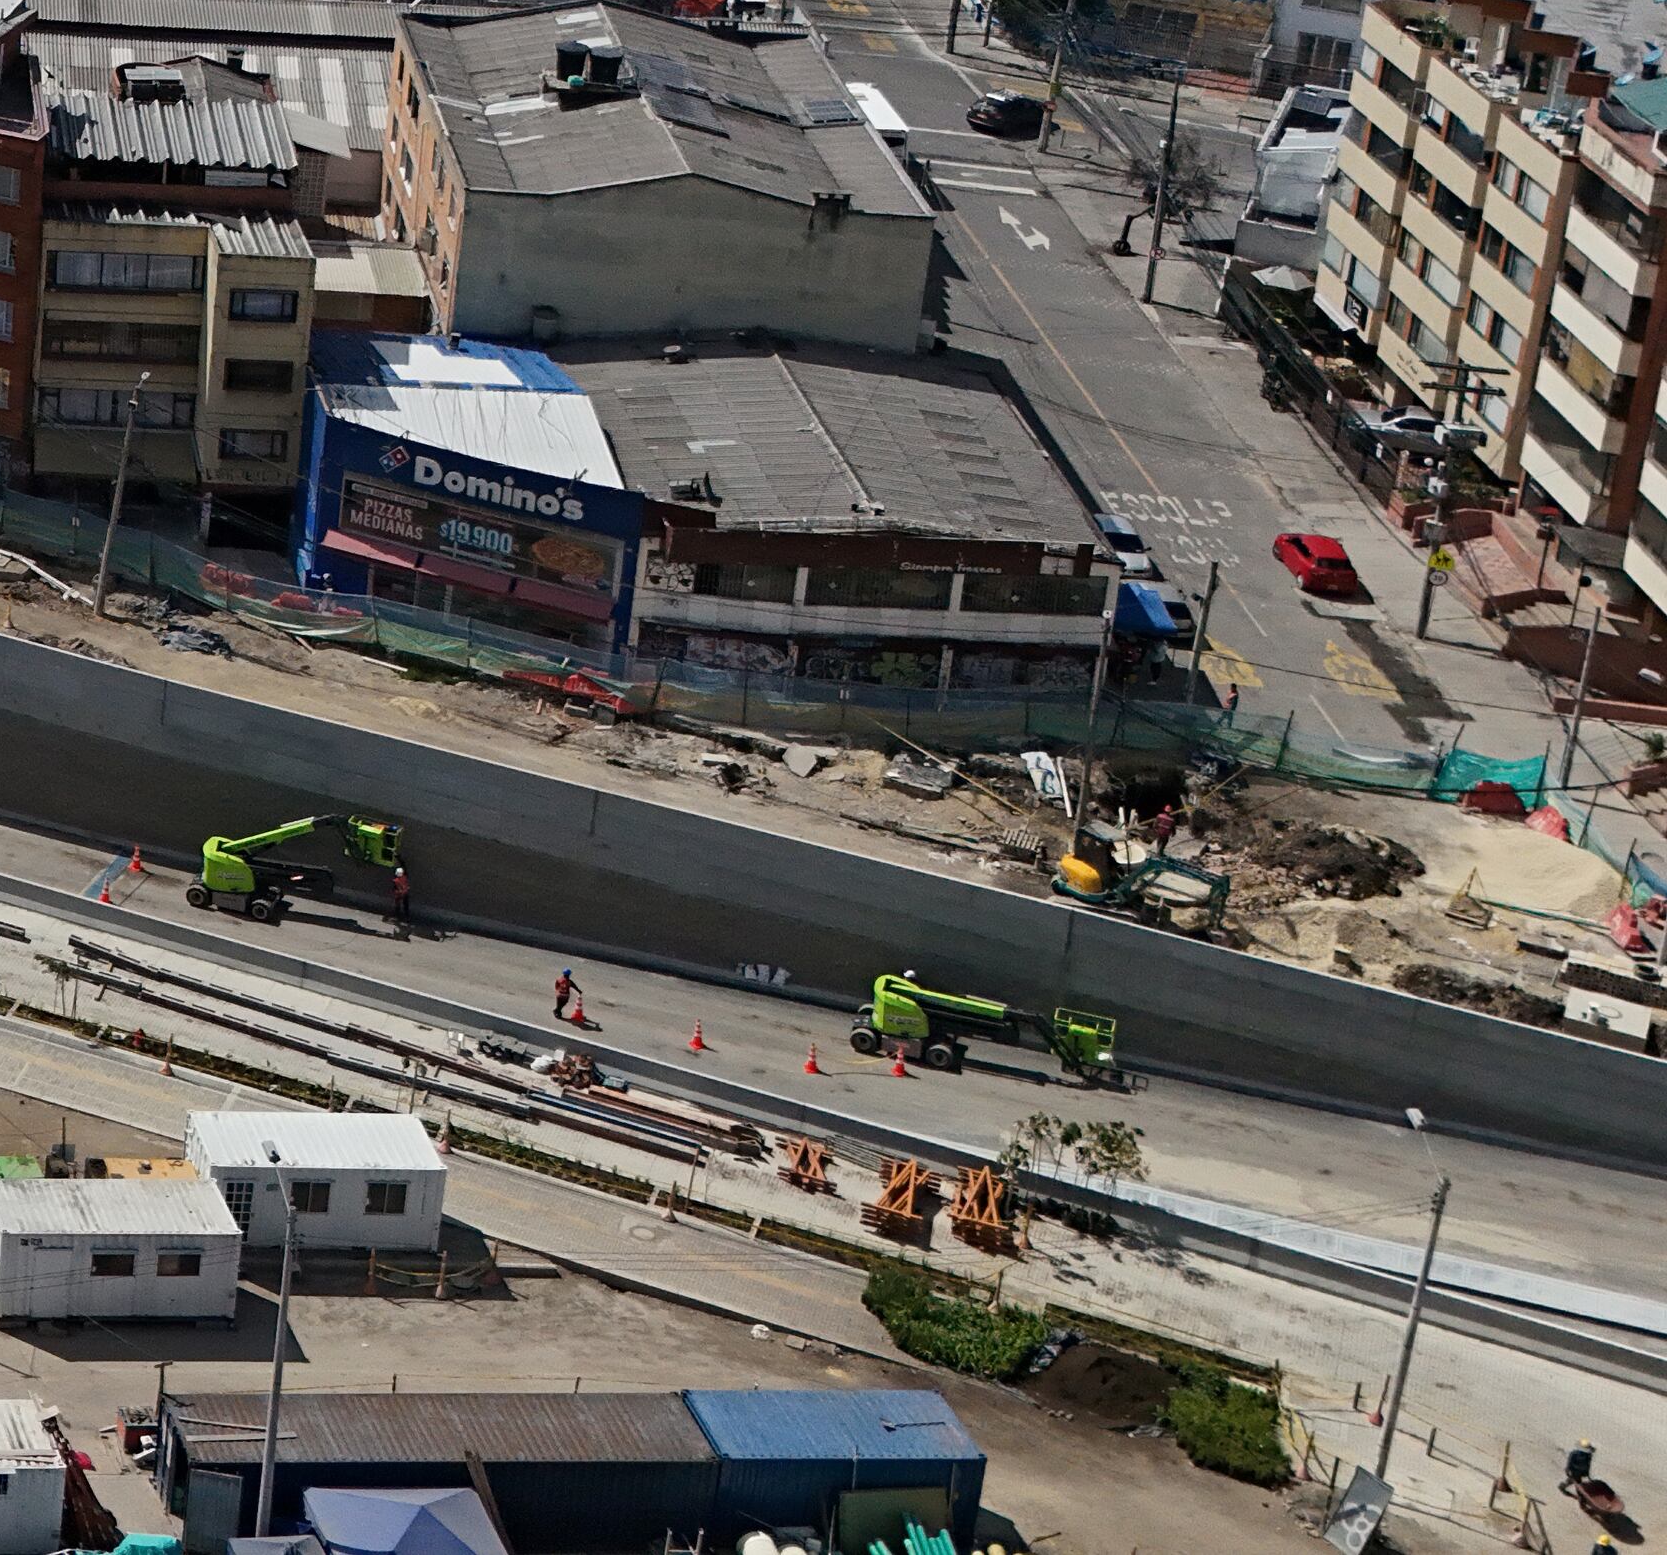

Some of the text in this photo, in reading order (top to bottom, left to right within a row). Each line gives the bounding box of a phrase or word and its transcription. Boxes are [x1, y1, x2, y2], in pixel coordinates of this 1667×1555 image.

[413, 455, 584, 521] Domino's
[350, 510, 423, 541] MEDIANAS
[363, 499, 413, 524] PIZZAS
